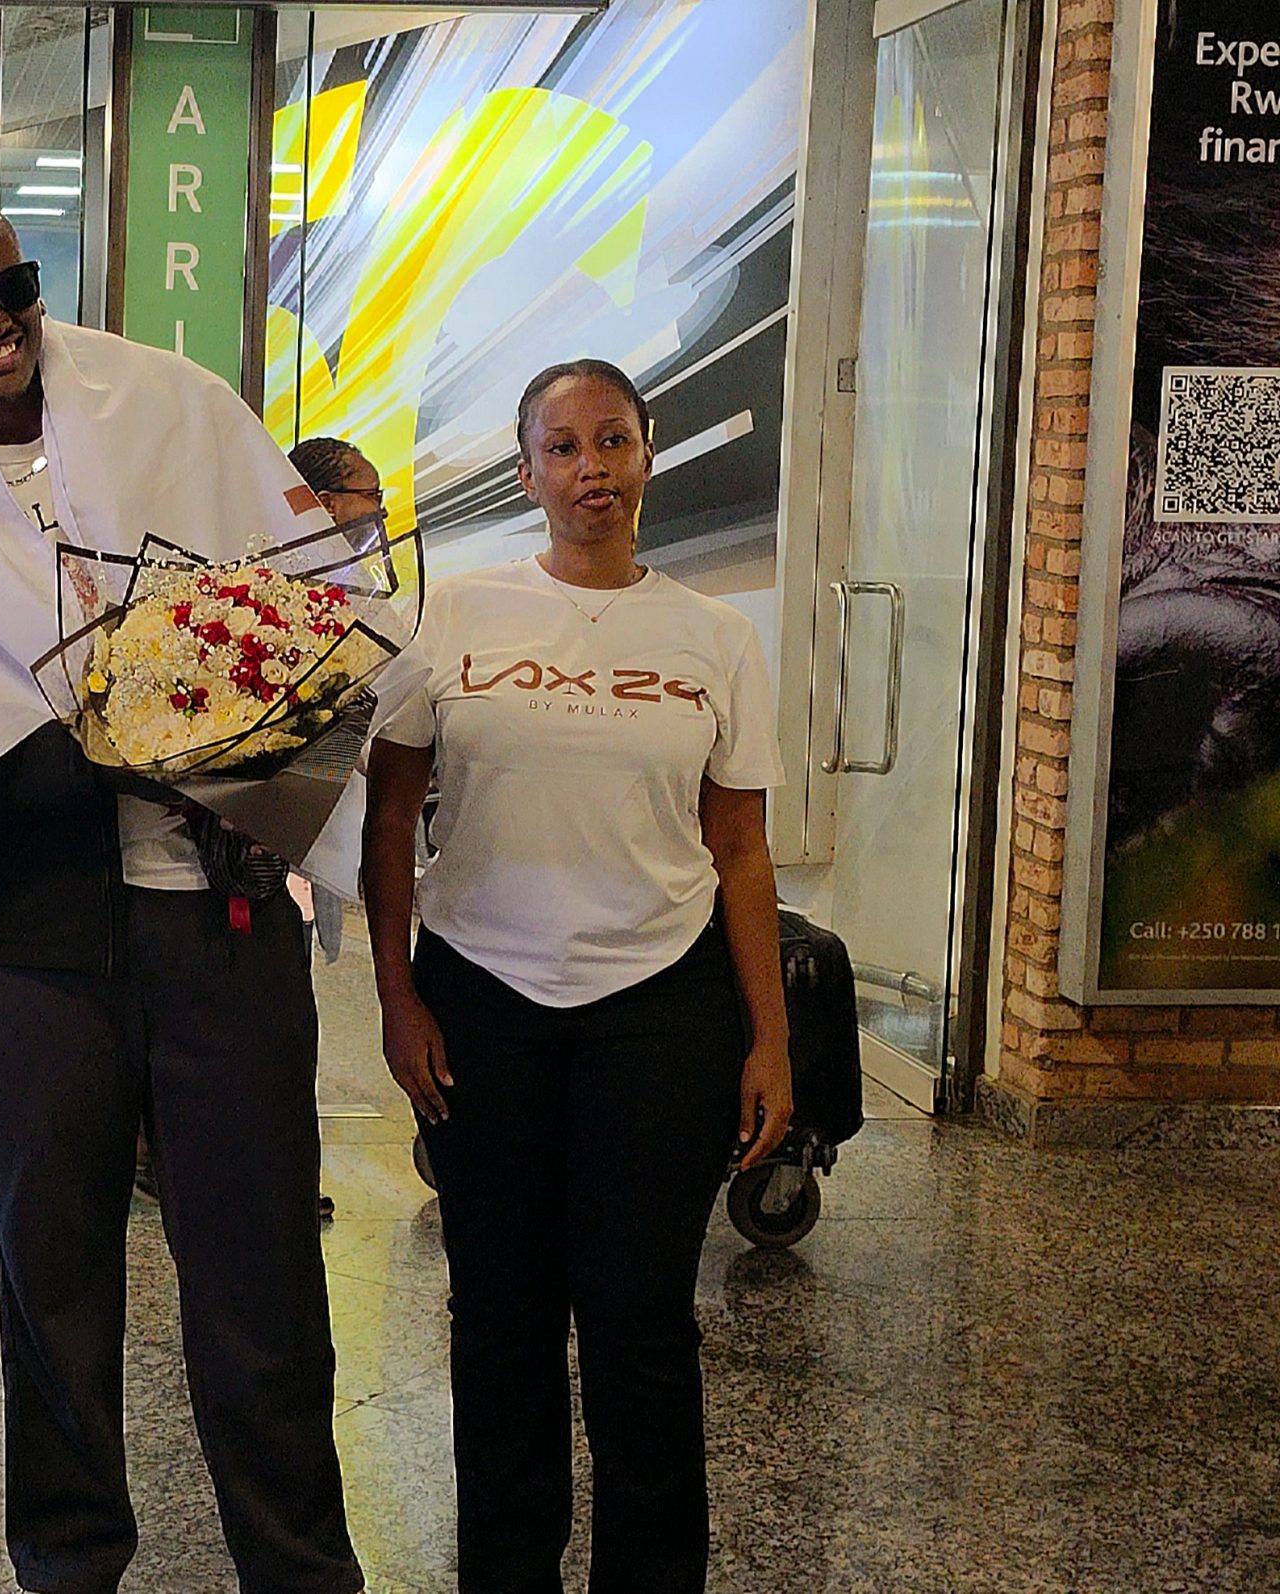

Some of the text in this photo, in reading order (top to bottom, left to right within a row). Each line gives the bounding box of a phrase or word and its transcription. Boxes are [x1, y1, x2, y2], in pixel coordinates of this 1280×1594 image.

[1196, 31, 1280, 77] Expe
[1153, 531, 1192, 543] SCAN
[1194, 531, 1215, 543] TO
[529, 700, 639, 719] BY MULAX
[1129, 921, 1172, 940] Call:
[1177, 922, 1226, 940] +250
[1231, 922, 1267, 940] 788
